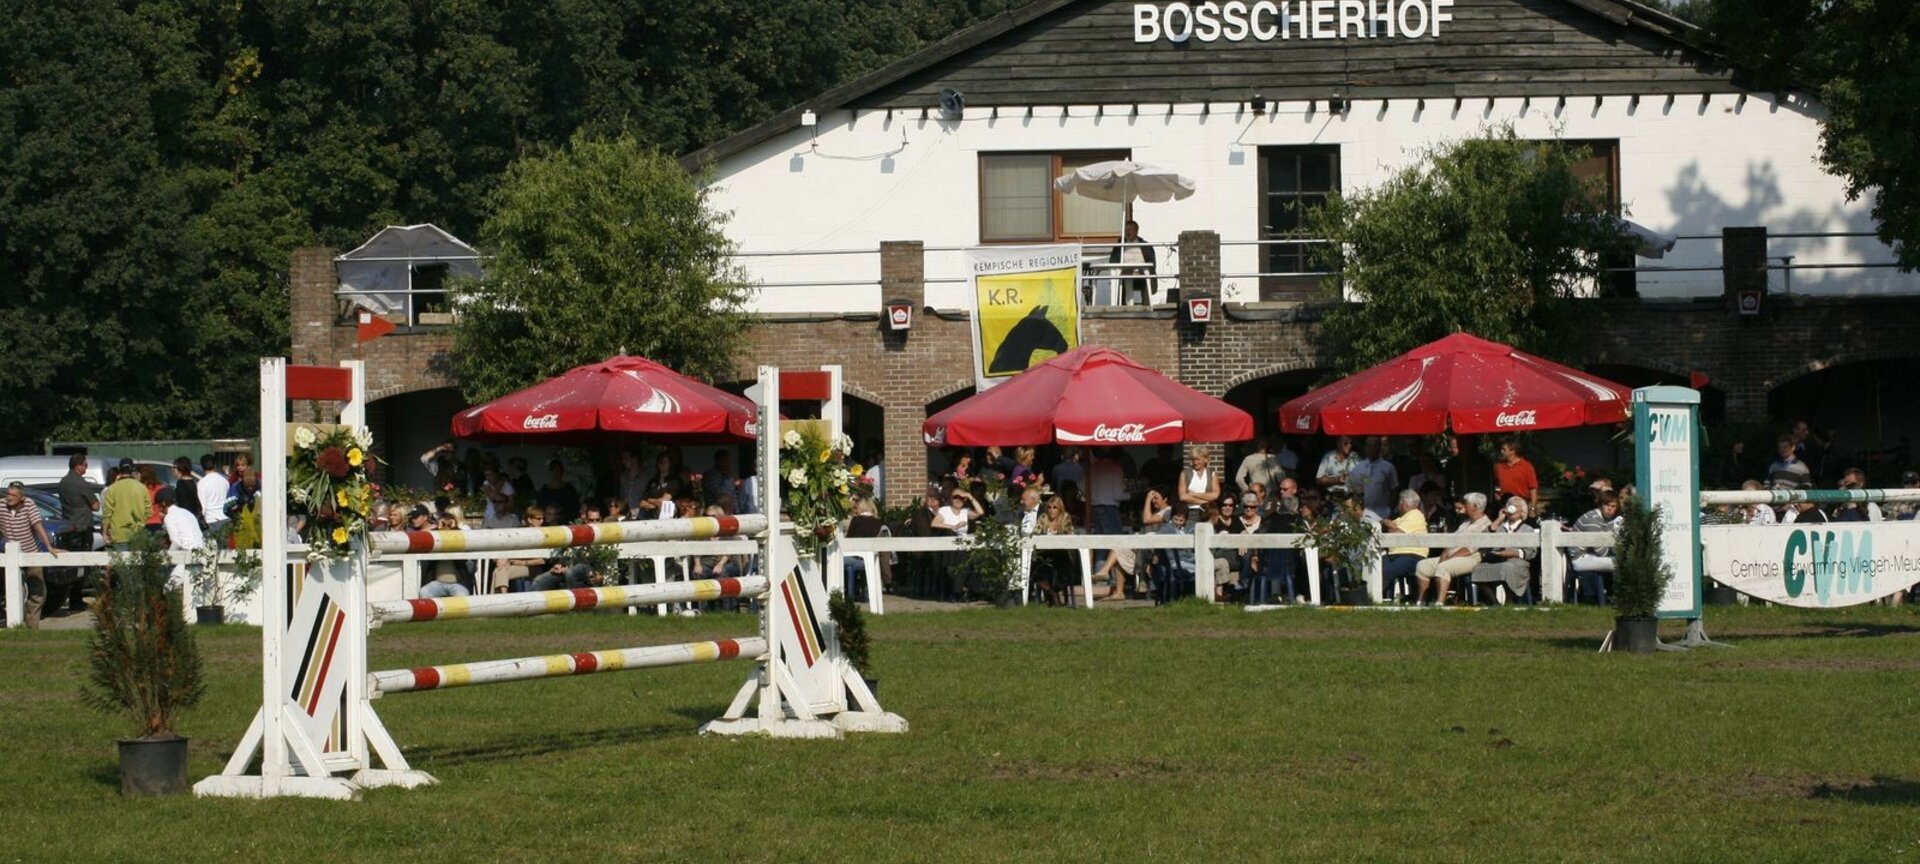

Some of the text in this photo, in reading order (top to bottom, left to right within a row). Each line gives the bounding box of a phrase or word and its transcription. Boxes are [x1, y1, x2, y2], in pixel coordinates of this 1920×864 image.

[1133, 0, 1455, 43] BOSSCHERHOF
[973, 253, 1079, 272] KEMPISCHE REGIONALE
[988, 288, 1023, 306] K.R.
[1495, 409, 1537, 428] Coca-Cola
[1093, 423, 1146, 442] Coca-Cola
[1730, 559, 1779, 578] Centrale
